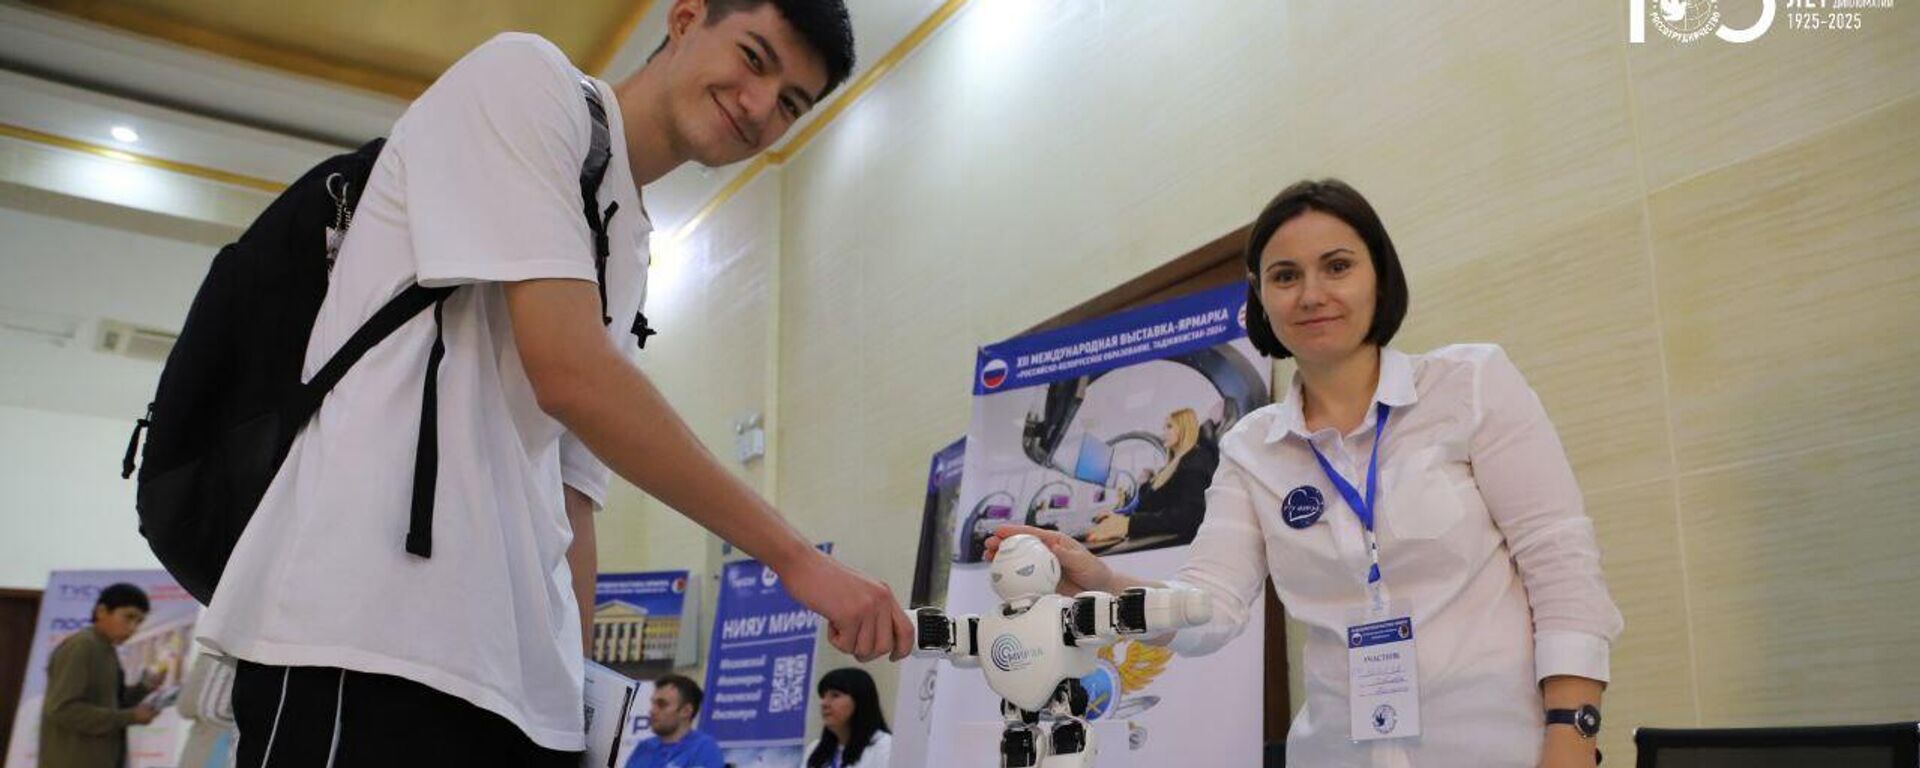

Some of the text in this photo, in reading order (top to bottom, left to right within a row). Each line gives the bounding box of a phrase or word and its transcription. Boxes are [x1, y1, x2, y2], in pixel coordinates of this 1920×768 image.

[1031, 334, 1118, 364] МЕЖДУНАРОДНАЯ
[1119, 308, 1229, 345] ВЫСТАВКА-ЯРМАРКА
[722, 615, 767, 640] НИЯУ
